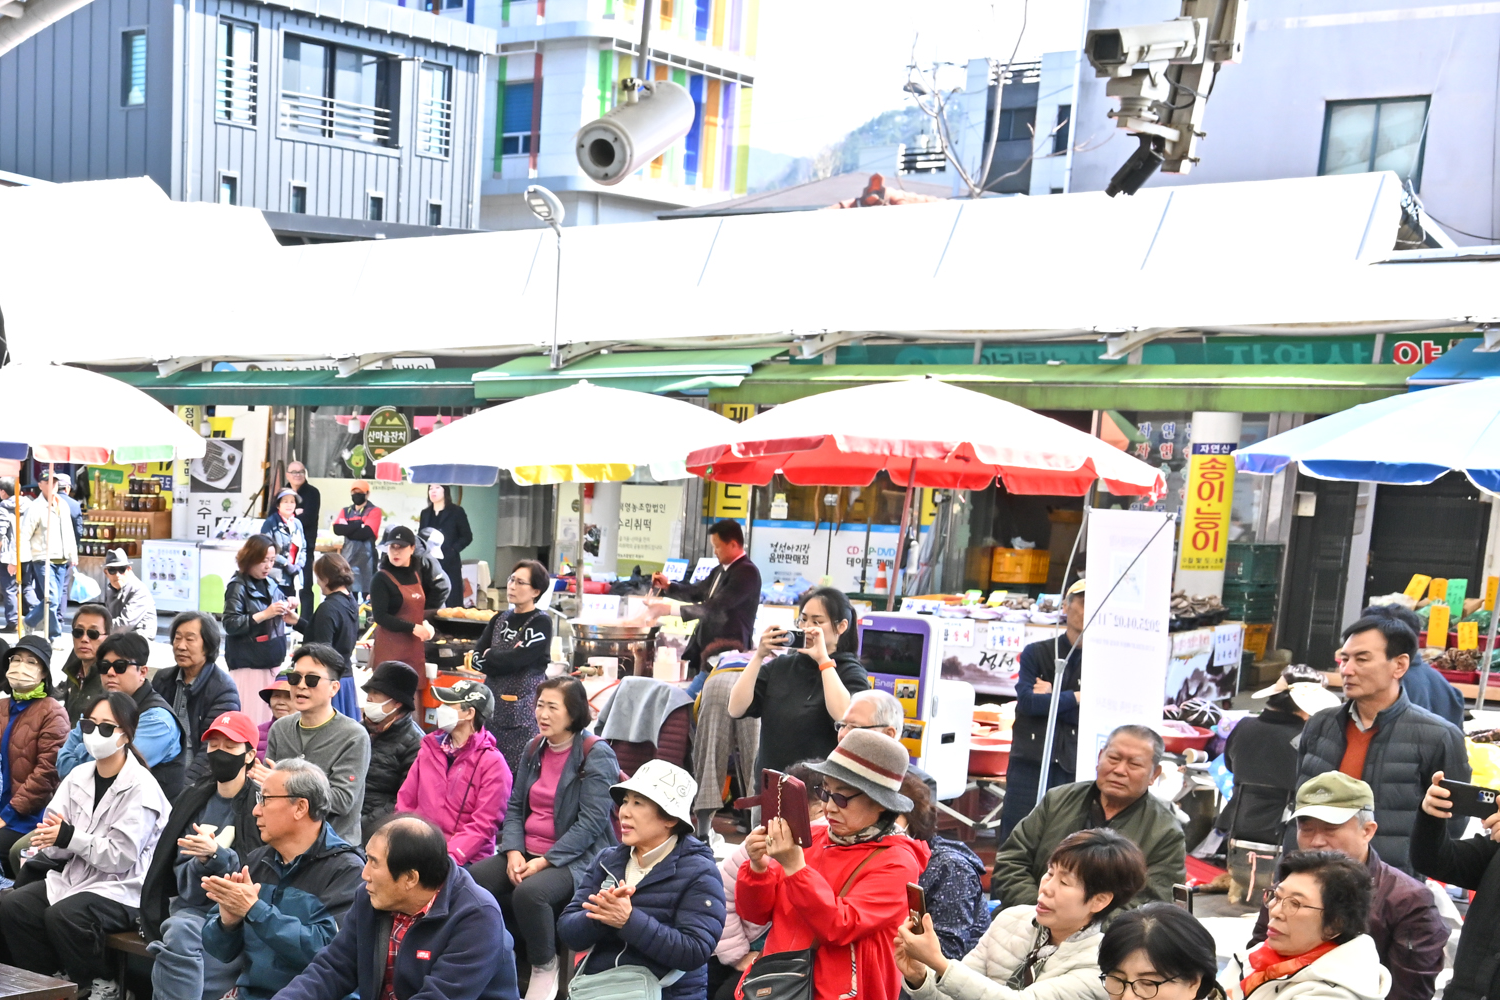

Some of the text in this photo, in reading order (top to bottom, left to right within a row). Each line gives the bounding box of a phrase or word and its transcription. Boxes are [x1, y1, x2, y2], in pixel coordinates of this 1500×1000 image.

[367, 430, 407, 444] 산마을잔치
[769, 553, 810, 566] 음반판매점
[979, 651, 1014, 671] 정선
